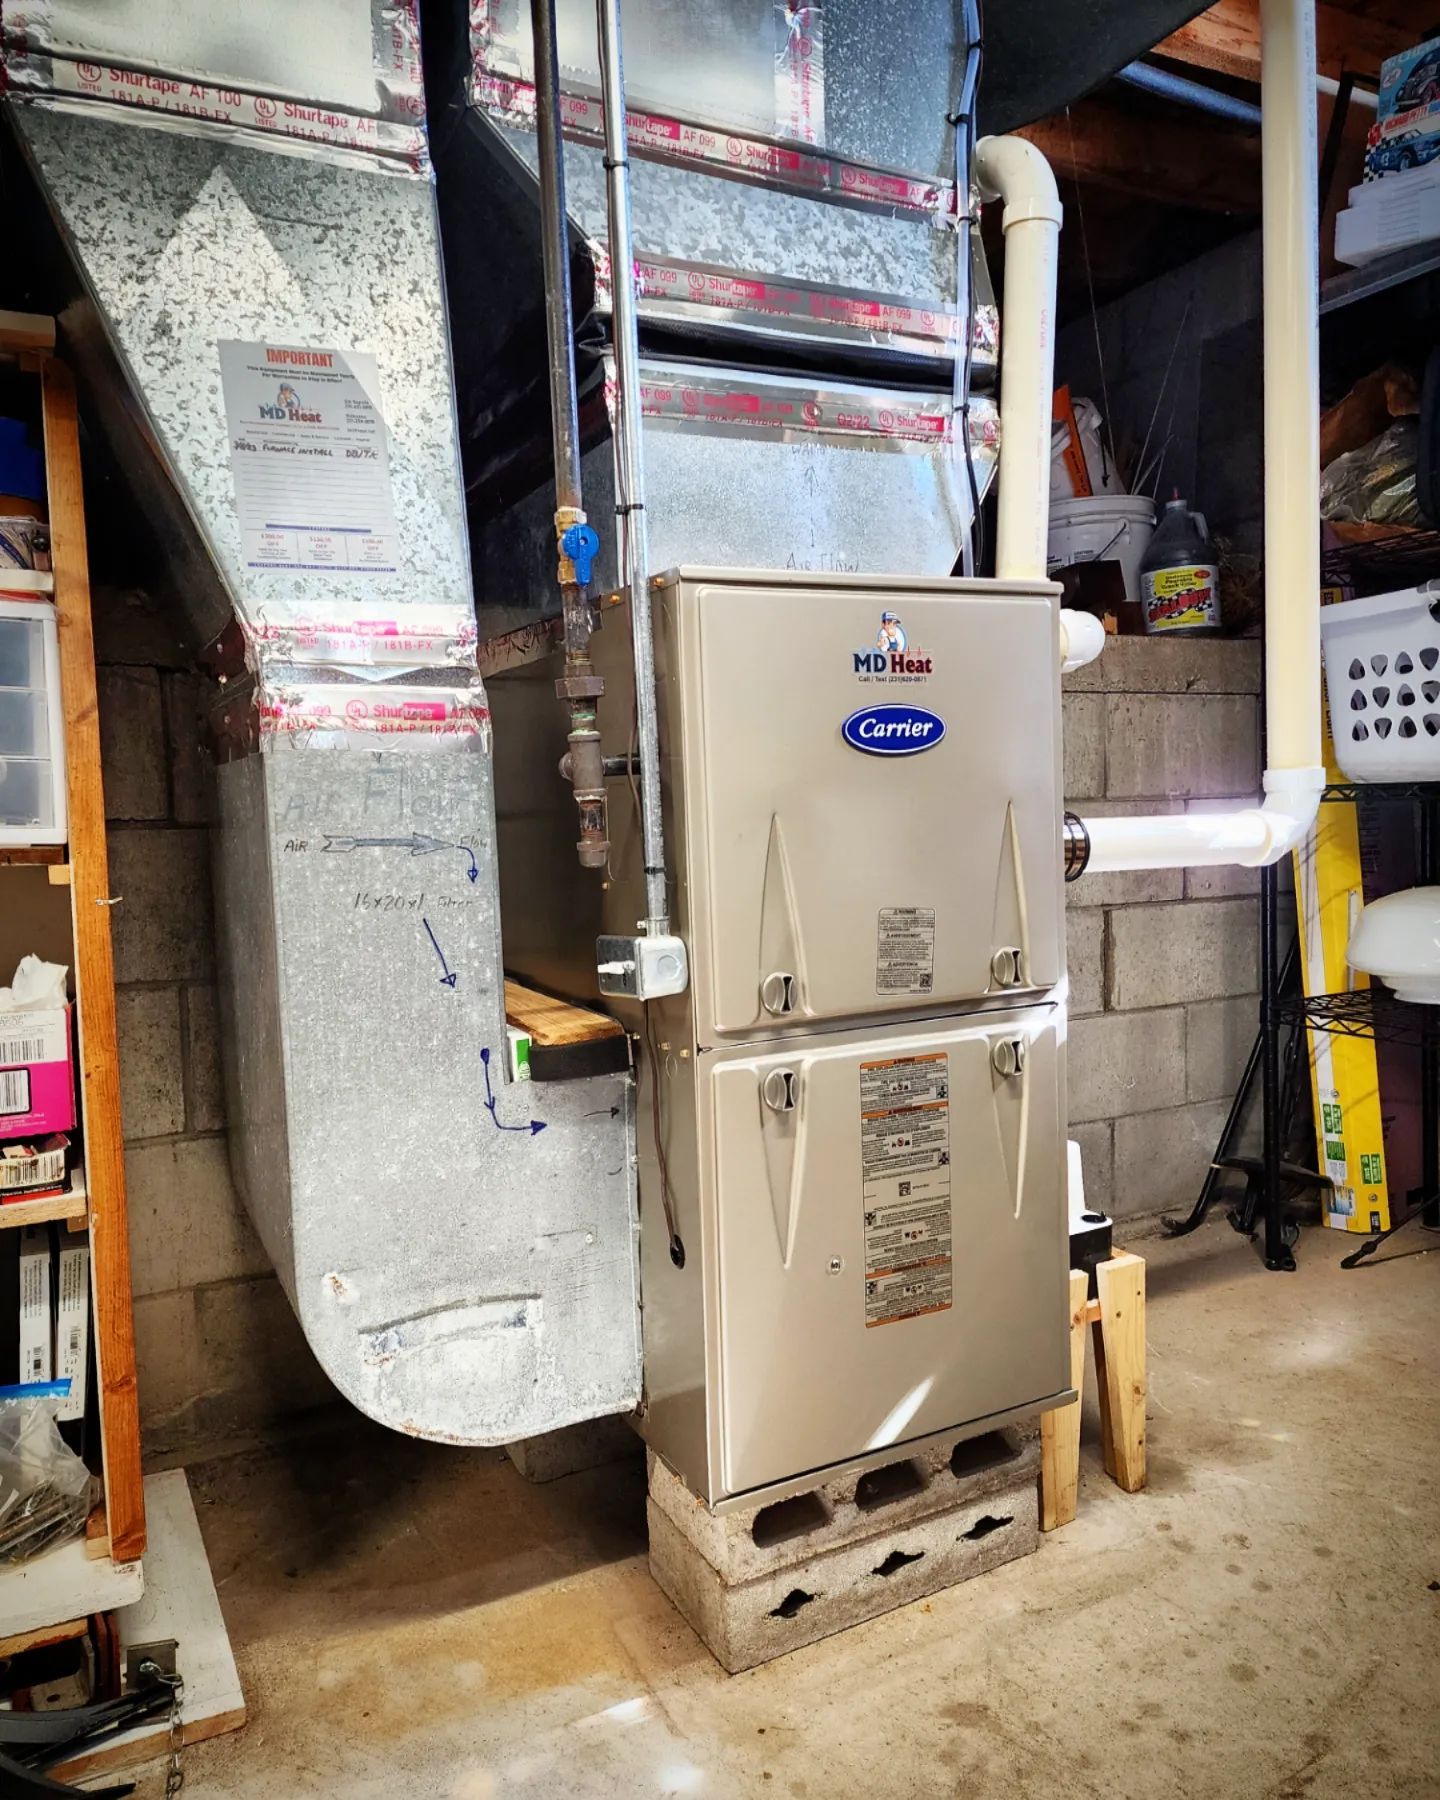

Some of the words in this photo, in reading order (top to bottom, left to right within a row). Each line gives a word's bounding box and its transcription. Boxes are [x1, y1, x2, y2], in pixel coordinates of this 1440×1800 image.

[109, 68, 181, 95] Shurtape
[189, 84, 210, 100] AF
[215, 90, 242, 107] 100
[284, 102, 349, 128] Shurtape
[356, 118, 376, 133] AF
[683, 128, 698, 143] AF
[699, 133, 716, 148] 099
[643, 267, 657, 280] AF
[266, 348, 334, 368] IMPORTANT
[259, 405, 286, 420] MD
[288, 407, 322, 422] Heat
[853, 654, 887, 673] MD
[891, 653, 932, 673] Heat
[859, 718, 934, 739] Carrier
